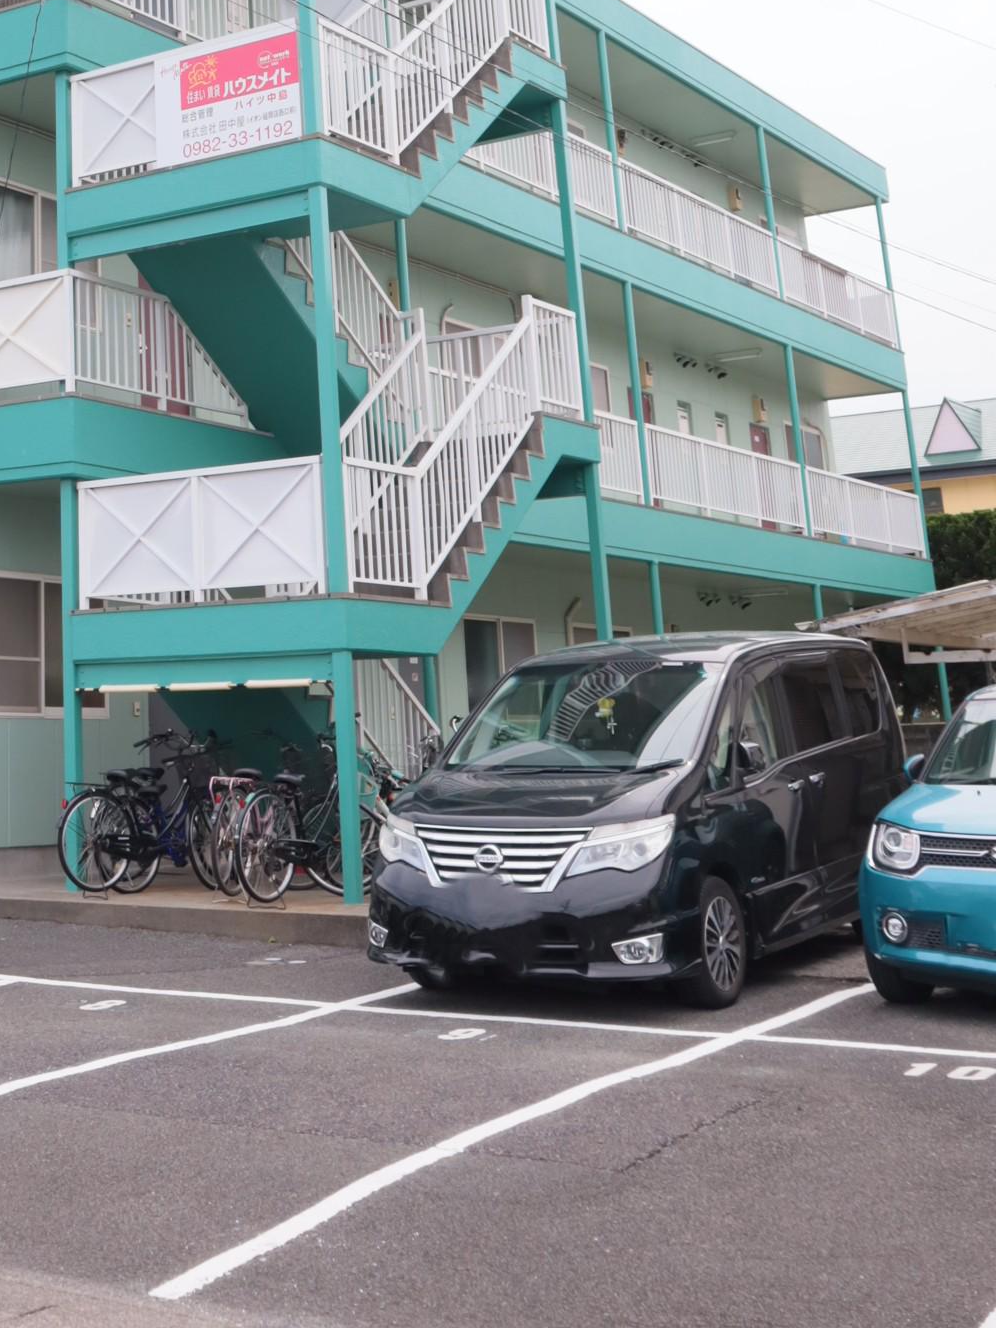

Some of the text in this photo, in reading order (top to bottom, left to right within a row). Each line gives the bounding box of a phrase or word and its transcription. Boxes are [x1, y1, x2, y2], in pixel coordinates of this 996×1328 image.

[223, 67, 292, 97] ハウスメイト
[182, 120, 293, 159] 0982-33-1192
[903, 1062, 996, 1081] 10
